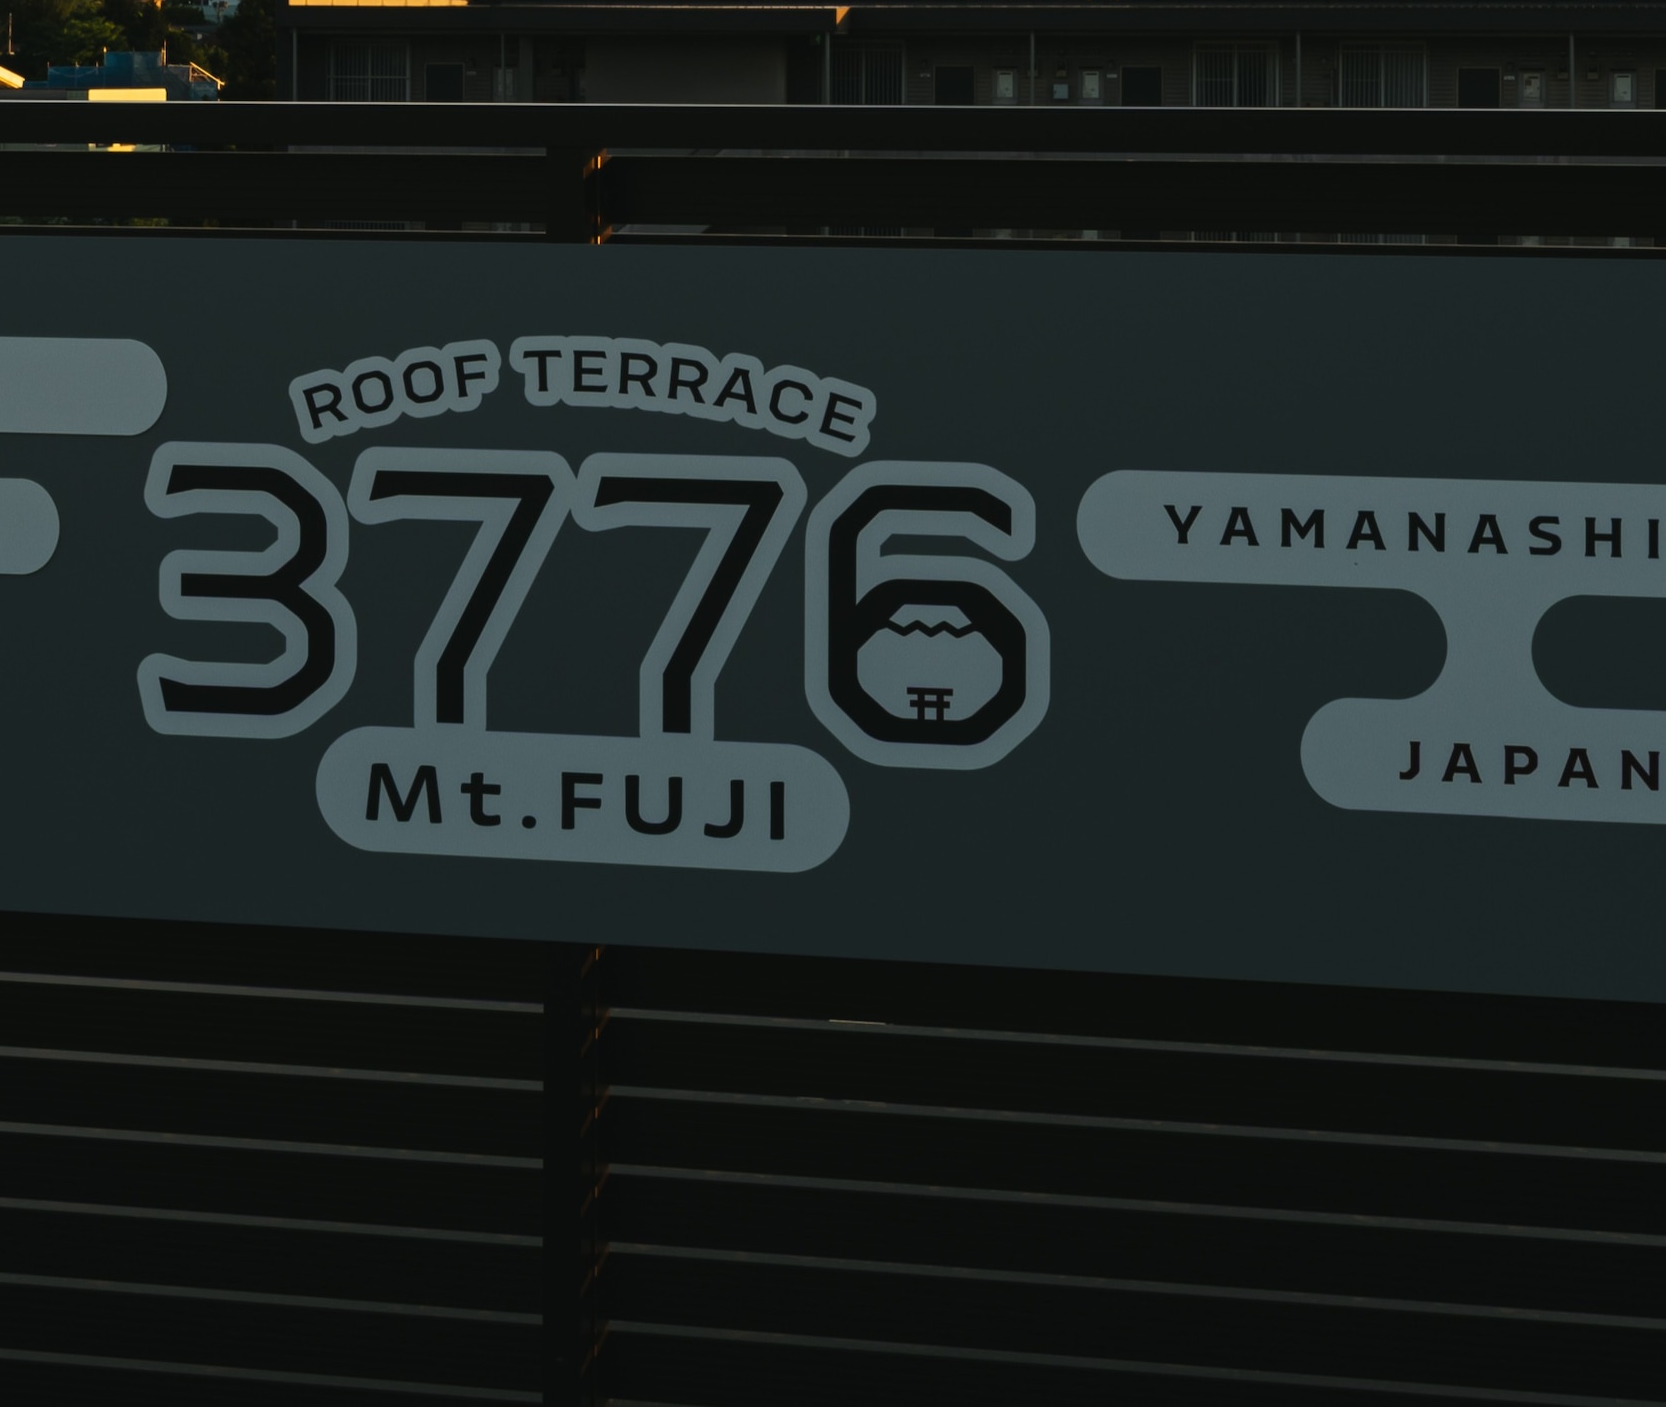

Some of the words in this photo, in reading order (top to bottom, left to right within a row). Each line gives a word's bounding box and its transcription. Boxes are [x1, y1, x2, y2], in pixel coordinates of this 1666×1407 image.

[302, 352, 489, 431] ROOF
[522, 348, 864, 444] TERRACE
[1163, 504, 1661, 560] YAMANASHI
[159, 464, 1027, 746] 3776
[1399, 740, 1661, 792] JAPAN
